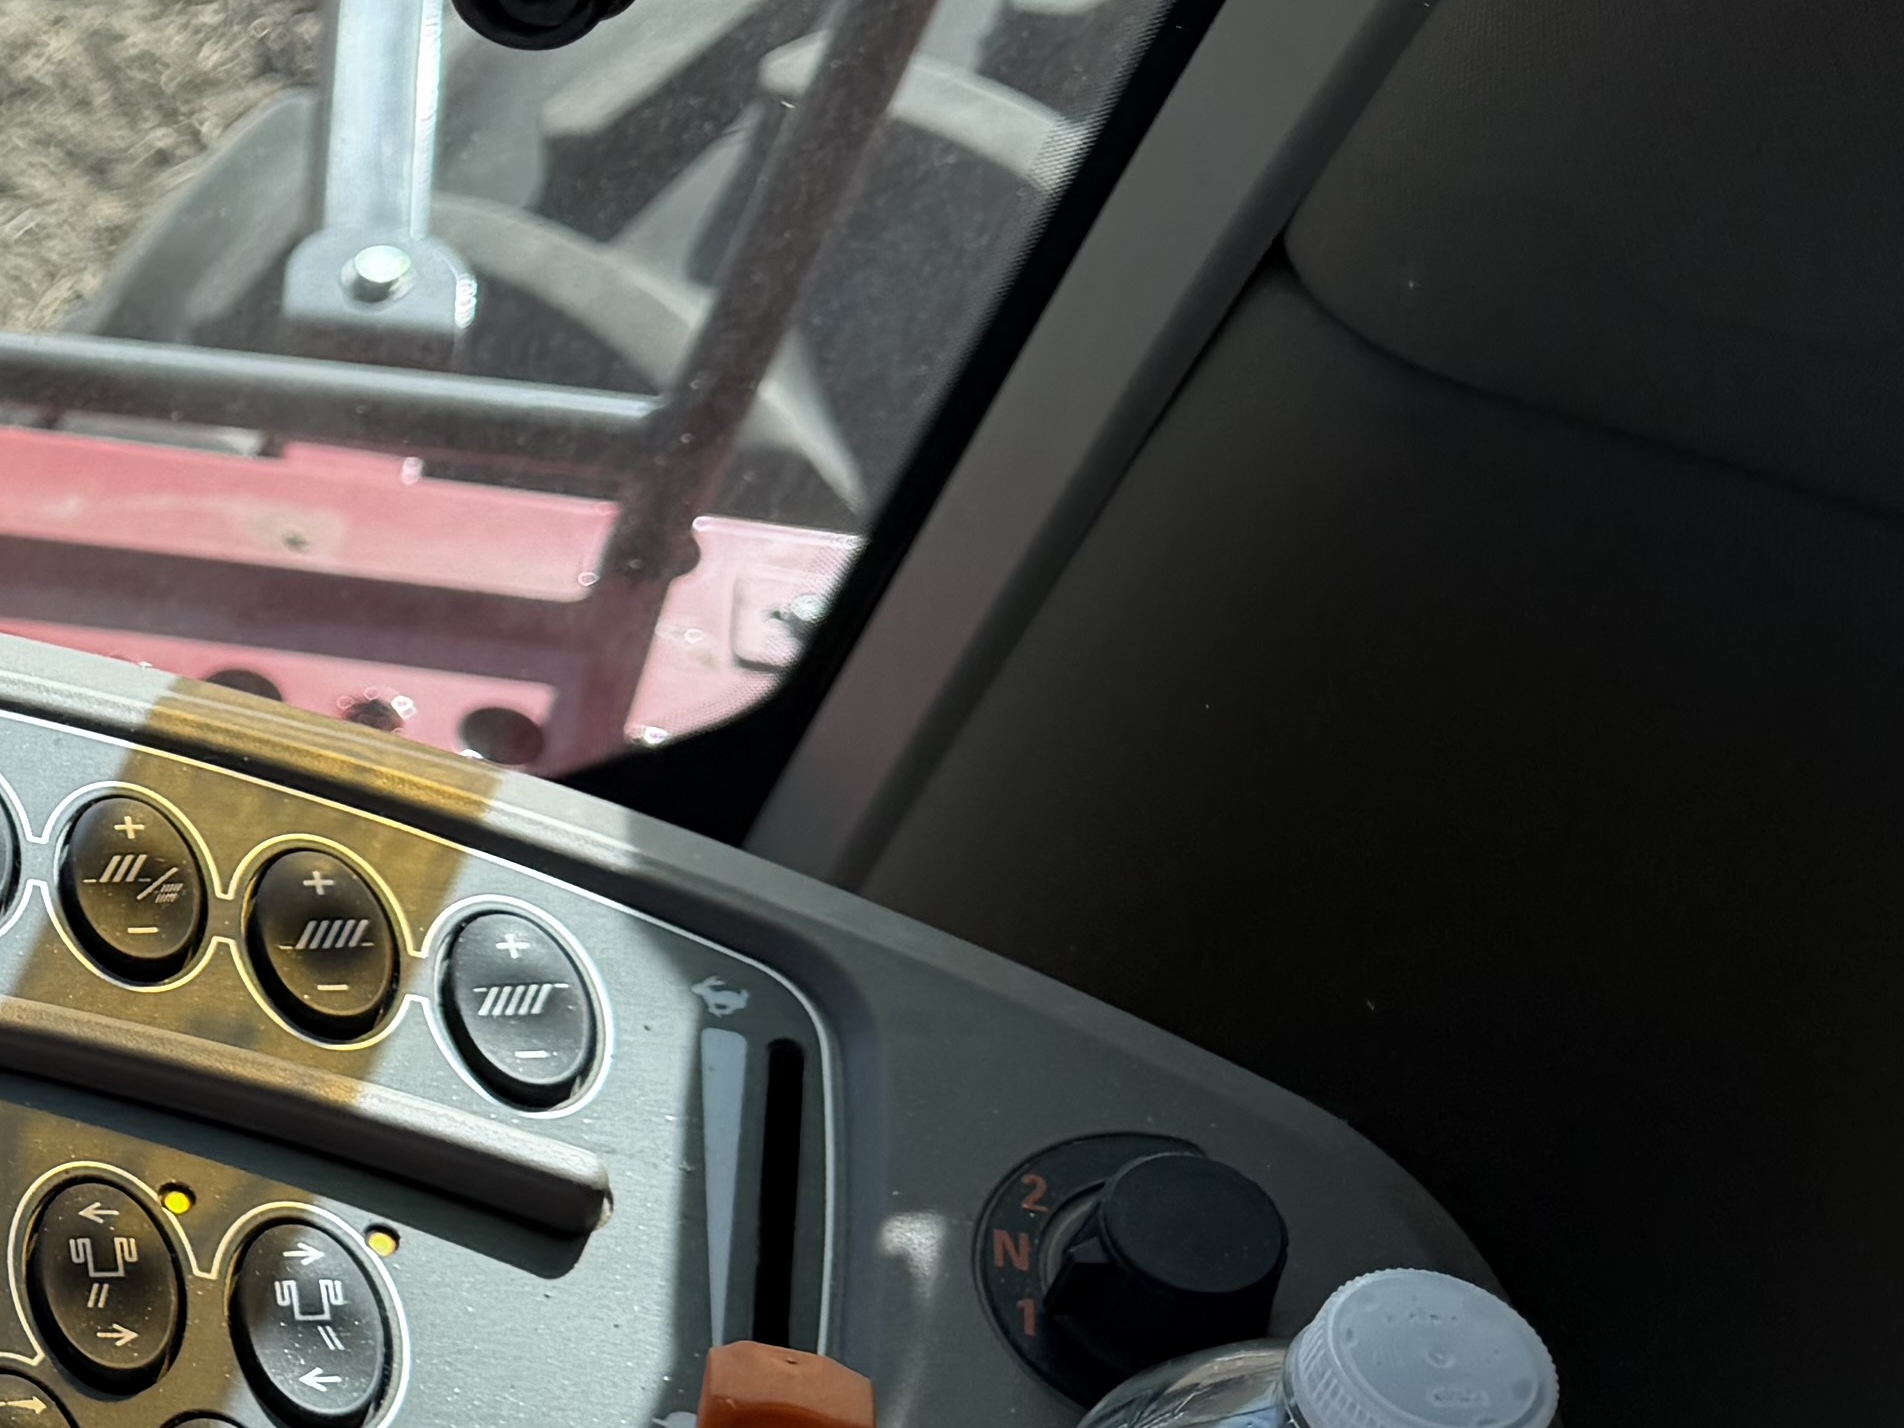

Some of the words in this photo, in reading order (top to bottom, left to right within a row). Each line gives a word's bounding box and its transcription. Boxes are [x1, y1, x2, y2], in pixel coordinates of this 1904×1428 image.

[1021, 1174, 1049, 1213] 2
[994, 1228, 1031, 1271] N
[1016, 1297, 1036, 1336] 1
